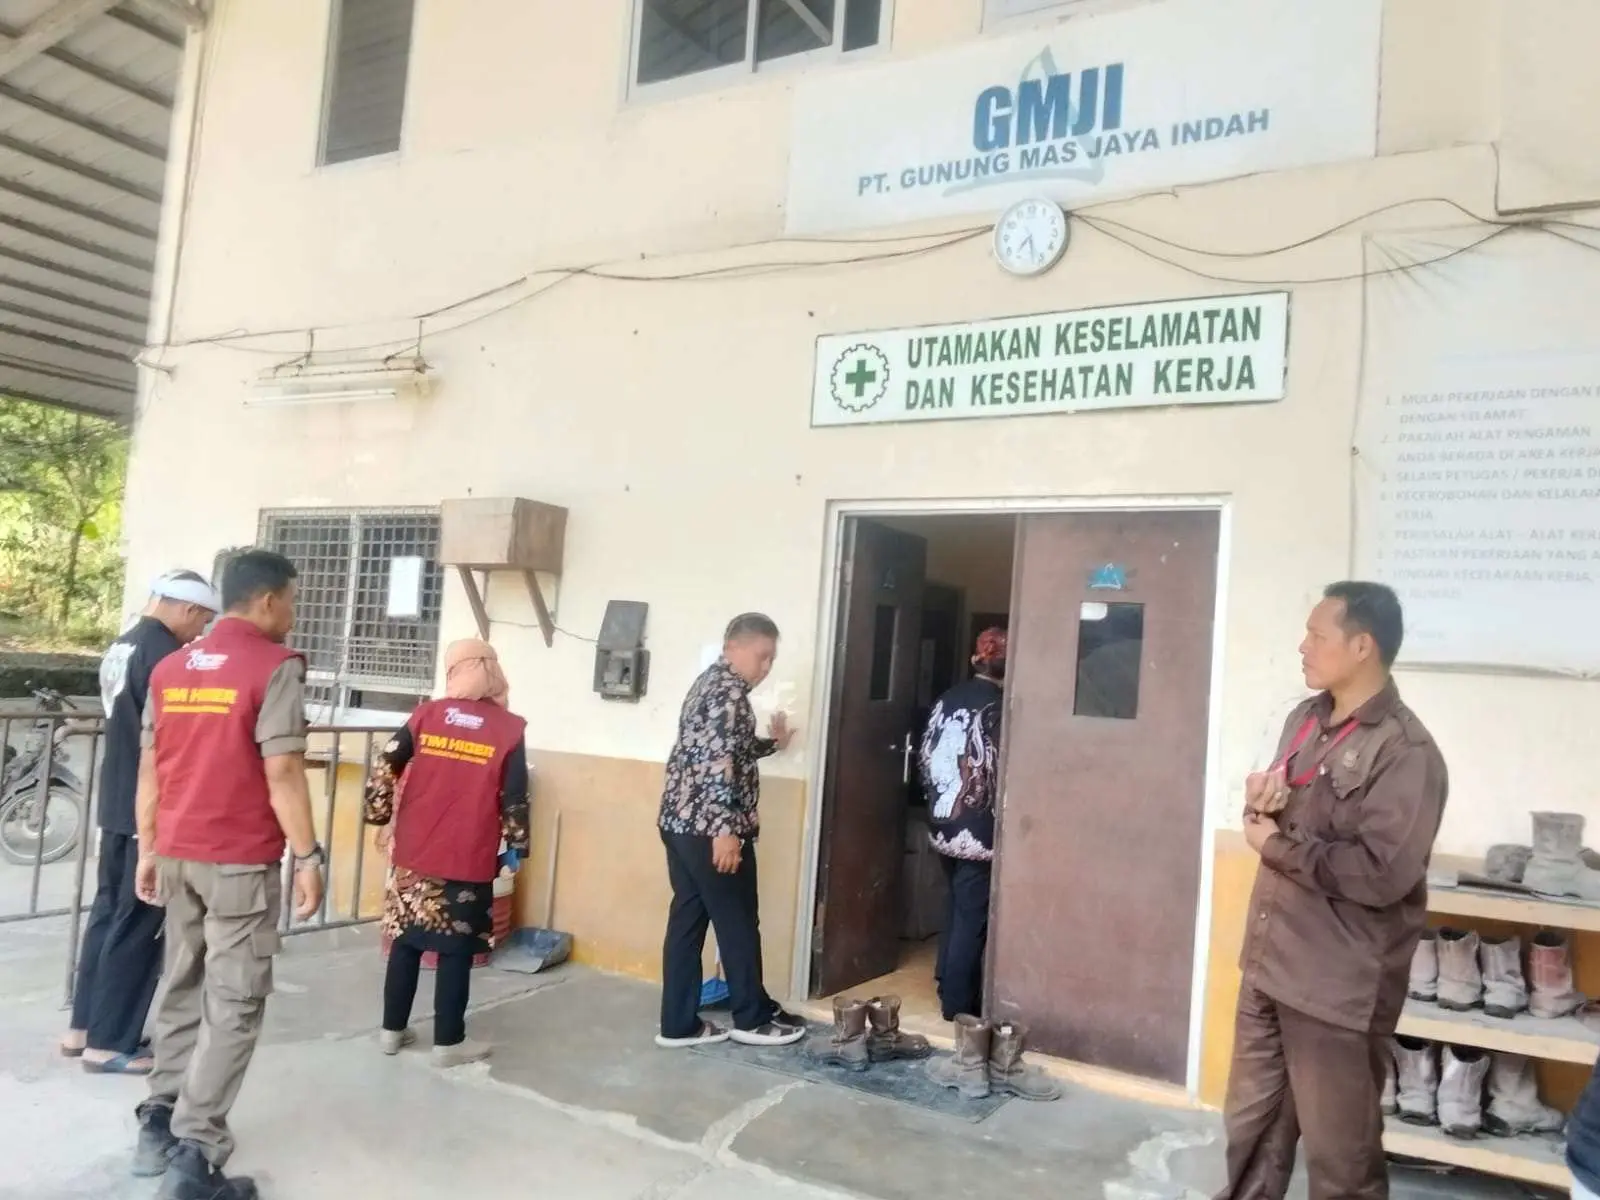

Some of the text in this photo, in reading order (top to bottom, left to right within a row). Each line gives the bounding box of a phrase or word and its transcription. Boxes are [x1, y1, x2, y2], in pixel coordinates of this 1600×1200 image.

[973, 62, 1124, 152] GMJI
[858, 108, 1270, 197] PT. GUNUNG MAS JAYA INDAH
[907, 305, 1262, 369] UTAMAKAN KESELAMATAN
[904, 354, 1256, 410] DAN KESEHATAN KERJA
[1447, 388, 1526, 403] PEKERJAAN
[1530, 386, 1591, 399] DENGAN
[1400, 411, 1456, 424] DENGAN
[1468, 429, 1502, 441] ALAT
[1506, 426, 1591, 440] PENGAMAN
[1396, 451, 1436, 463] ANDA
[1516, 447, 1555, 460] AREA
[1445, 469, 1507, 481] PETUGAS
[1523, 467, 1583, 480] PEKERJA
[1502, 489, 1534, 500] DAN
[1529, 527, 1565, 540] ALAT
[1546, 548, 1587, 561] YANG
[419, 733, 448, 750] TIM
